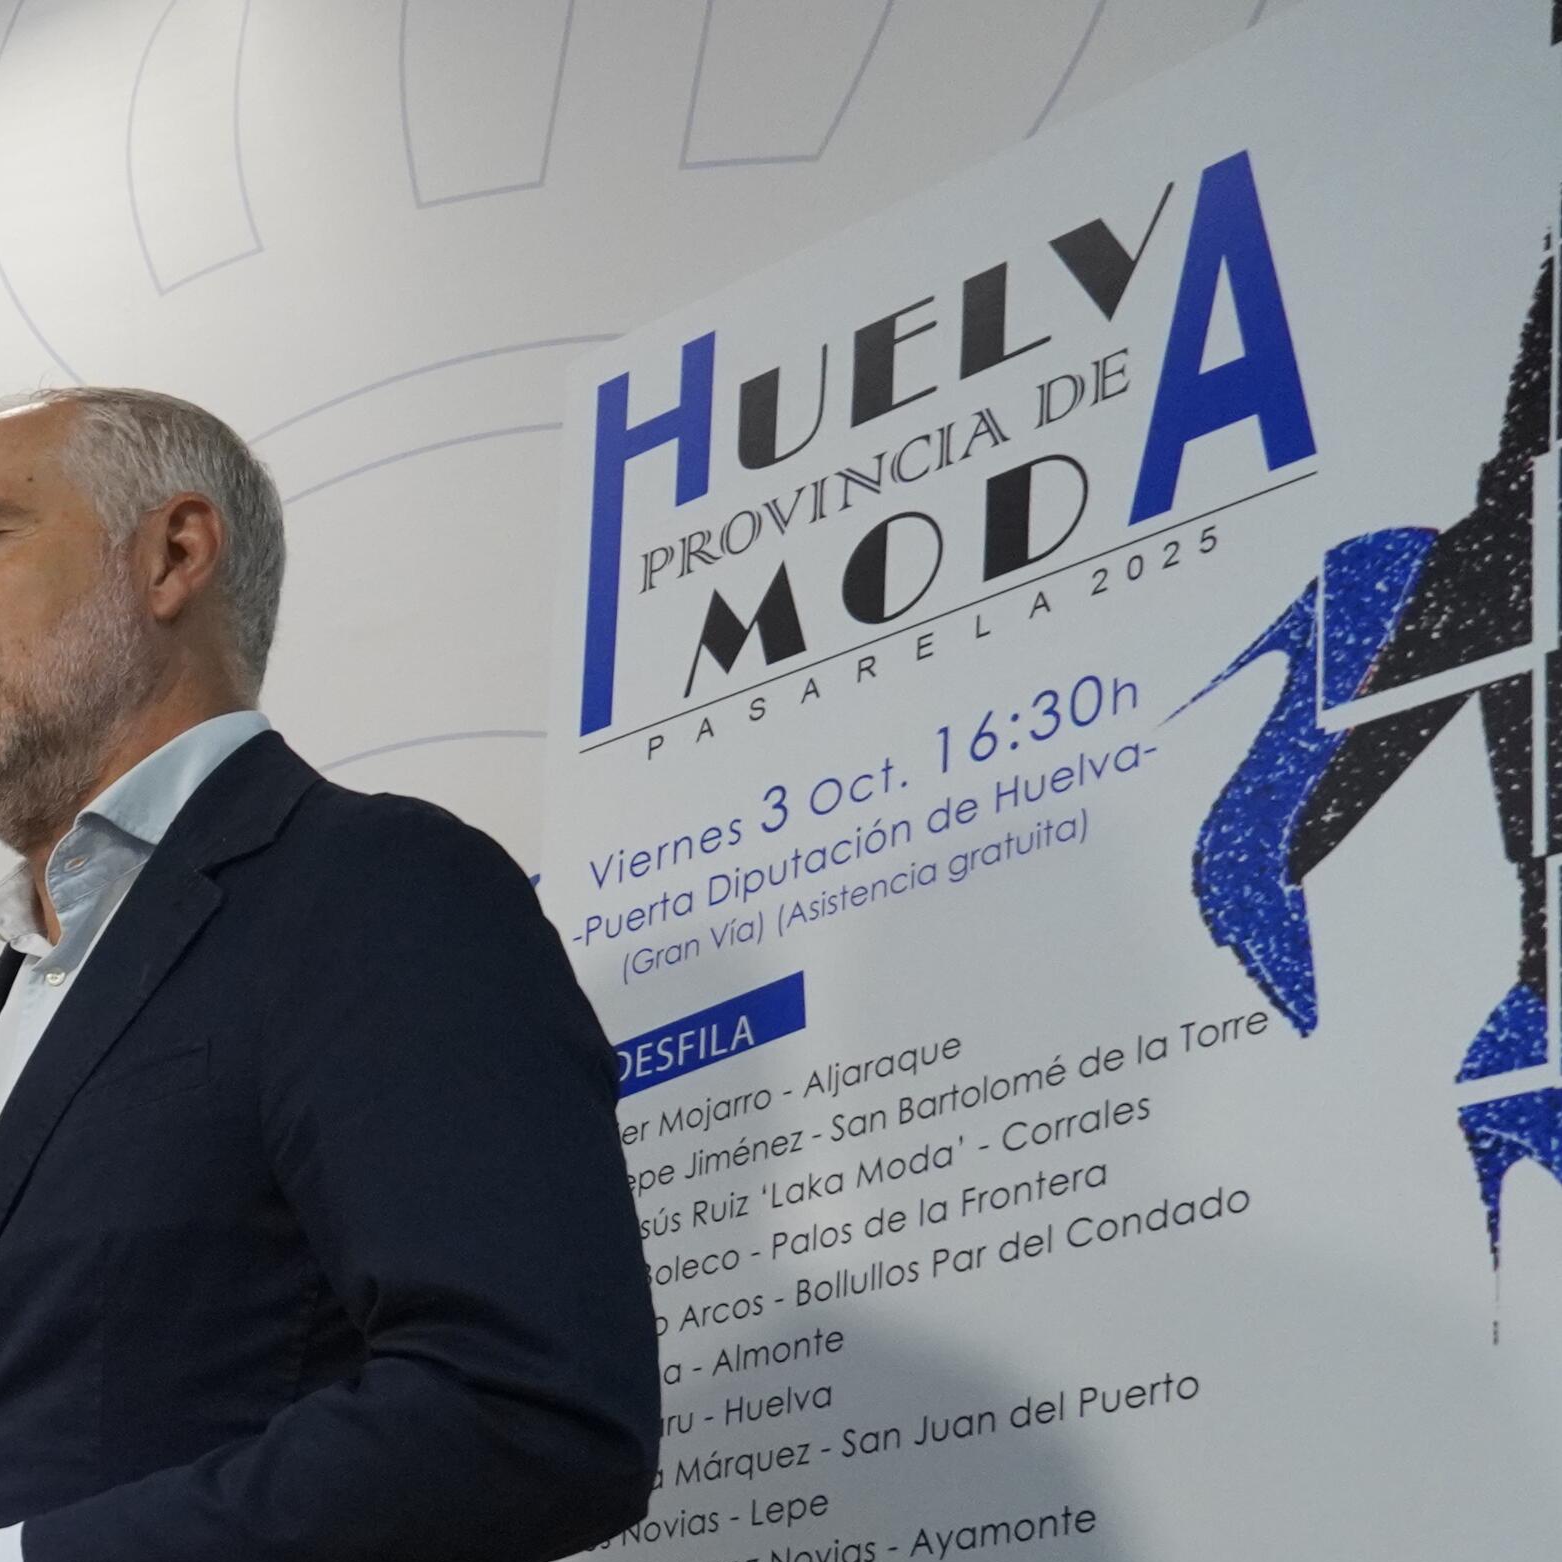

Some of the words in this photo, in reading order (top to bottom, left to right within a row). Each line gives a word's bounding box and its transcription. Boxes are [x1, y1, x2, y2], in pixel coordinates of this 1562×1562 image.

[639, 408, 1010, 594] PROVINCIA
[1035, 347, 1133, 429] DE
[647, 592, 1053, 761] PASARELA
[1091, 526, 1220, 598] 2025
[589, 818, 743, 889] Viernes
[761, 785, 789, 833] 3
[809, 758, 908, 816] Oct.
[936, 675, 1139, 774] 16:30h
[621, 936, 700, 984] (Gran
[710, 911, 765, 950] Vía)
[777, 861, 937, 938] (Asistencia
[948, 808, 1089, 884] gratuita)
[708, 819, 912, 907] Diputación
[927, 798, 978, 834] de
[627, 1163, 676, 1198] epe
[684, 1130, 804, 1179] Jiménez
[830, 1107, 887, 1144] San
[898, 1054, 1067, 1127] Bartolomé
[1078, 1046, 1125, 1079] de
[1137, 1033, 1169, 1066] la
[1179, 1010, 1270, 1054] Torre
[658, 1089, 773, 1136] Mojarro
[802, 1036, 963, 1099] Aljaraque
[639, 1207, 682, 1240] sús
[692, 1192, 750, 1228] Ruiz
[1001, 1096, 1151, 1153] Corrales
[772, 1222, 853, 1261] Palos
[864, 1207, 907, 1239] de
[919, 1197, 948, 1227] la
[961, 1162, 1108, 1218] Frontera
[679, 1294, 764, 1332] Arcos
[795, 1258, 920, 1308] Bollullos
[932, 1243, 987, 1279] Par
[998, 1224, 1054, 1262] del
[1066, 1186, 1251, 1249] Condado
[711, 1328, 845, 1377] Almonte
[725, 1386, 833, 1427] Huelva
[675, 1442, 811, 1487] Márquez
[840, 1424, 901, 1458] San
[913, 1408, 997, 1447] Juan
[1009, 1391, 1065, 1429] del
[1078, 1371, 1200, 1418] Puerto
[750, 1493, 829, 1528] Lepe
[909, 1505, 1098, 1561] Ayamonte
